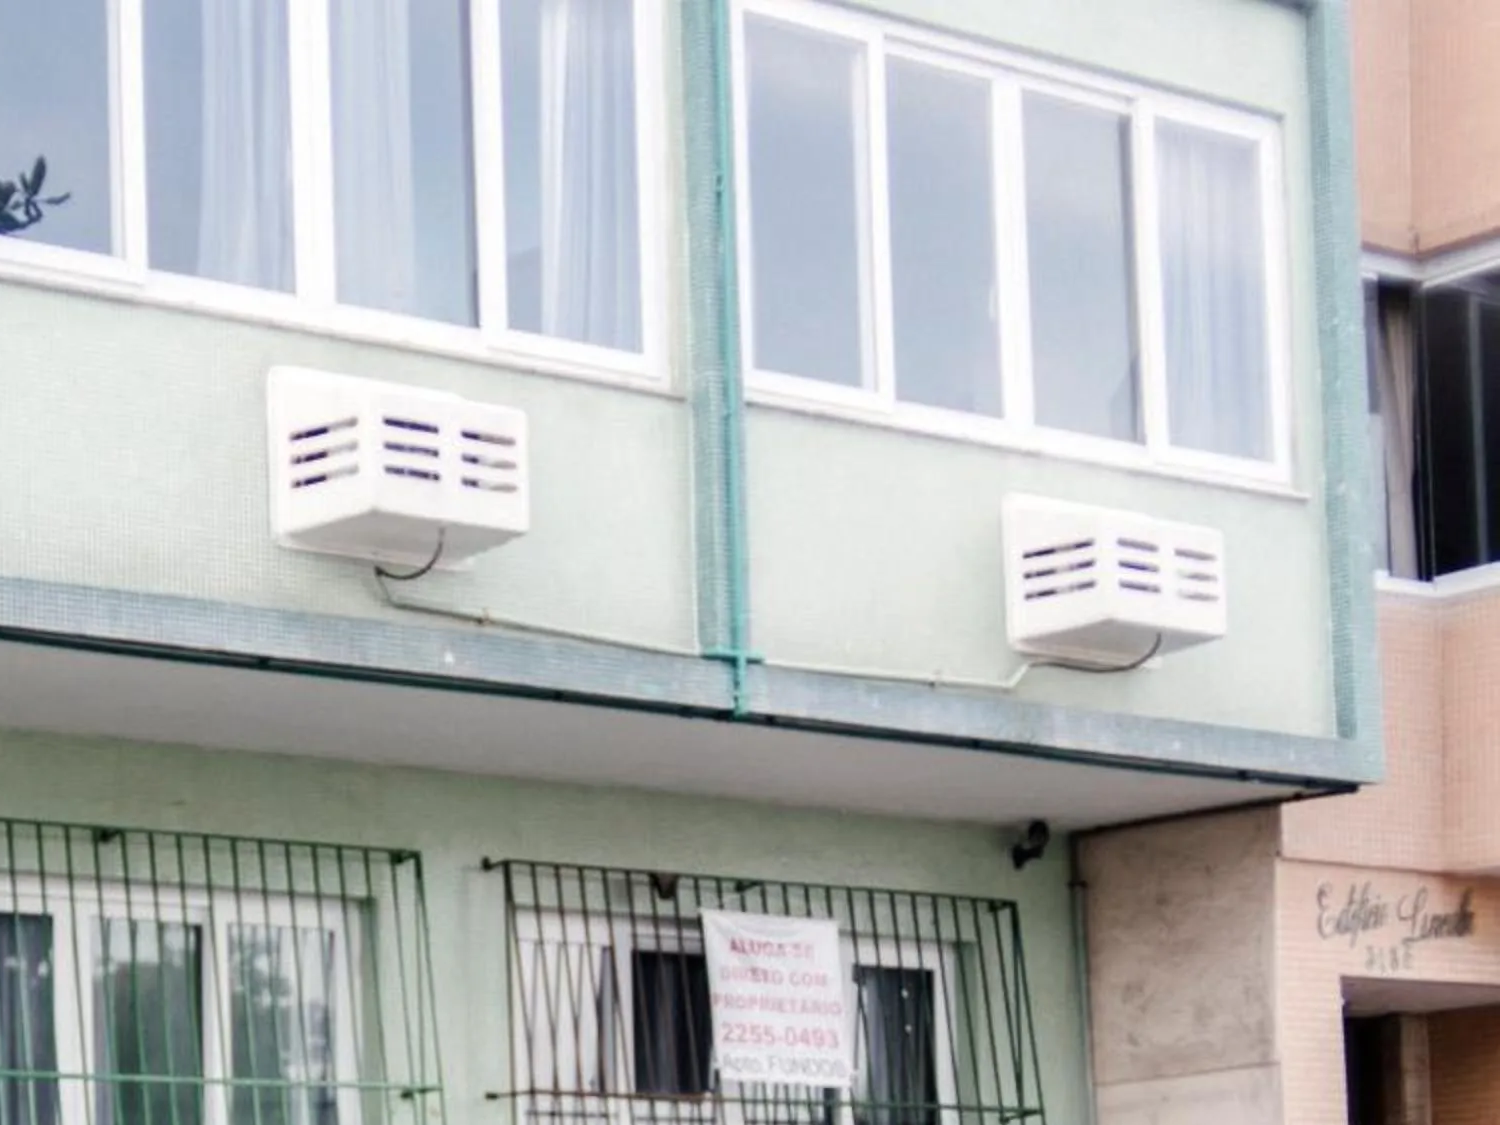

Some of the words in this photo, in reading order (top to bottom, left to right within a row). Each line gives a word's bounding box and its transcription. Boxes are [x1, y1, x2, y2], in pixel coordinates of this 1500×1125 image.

[729, 937, 815, 958] ALUGA-SE
[789, 971, 828, 988] COM
[721, 1022, 839, 1049] 2255-0493
